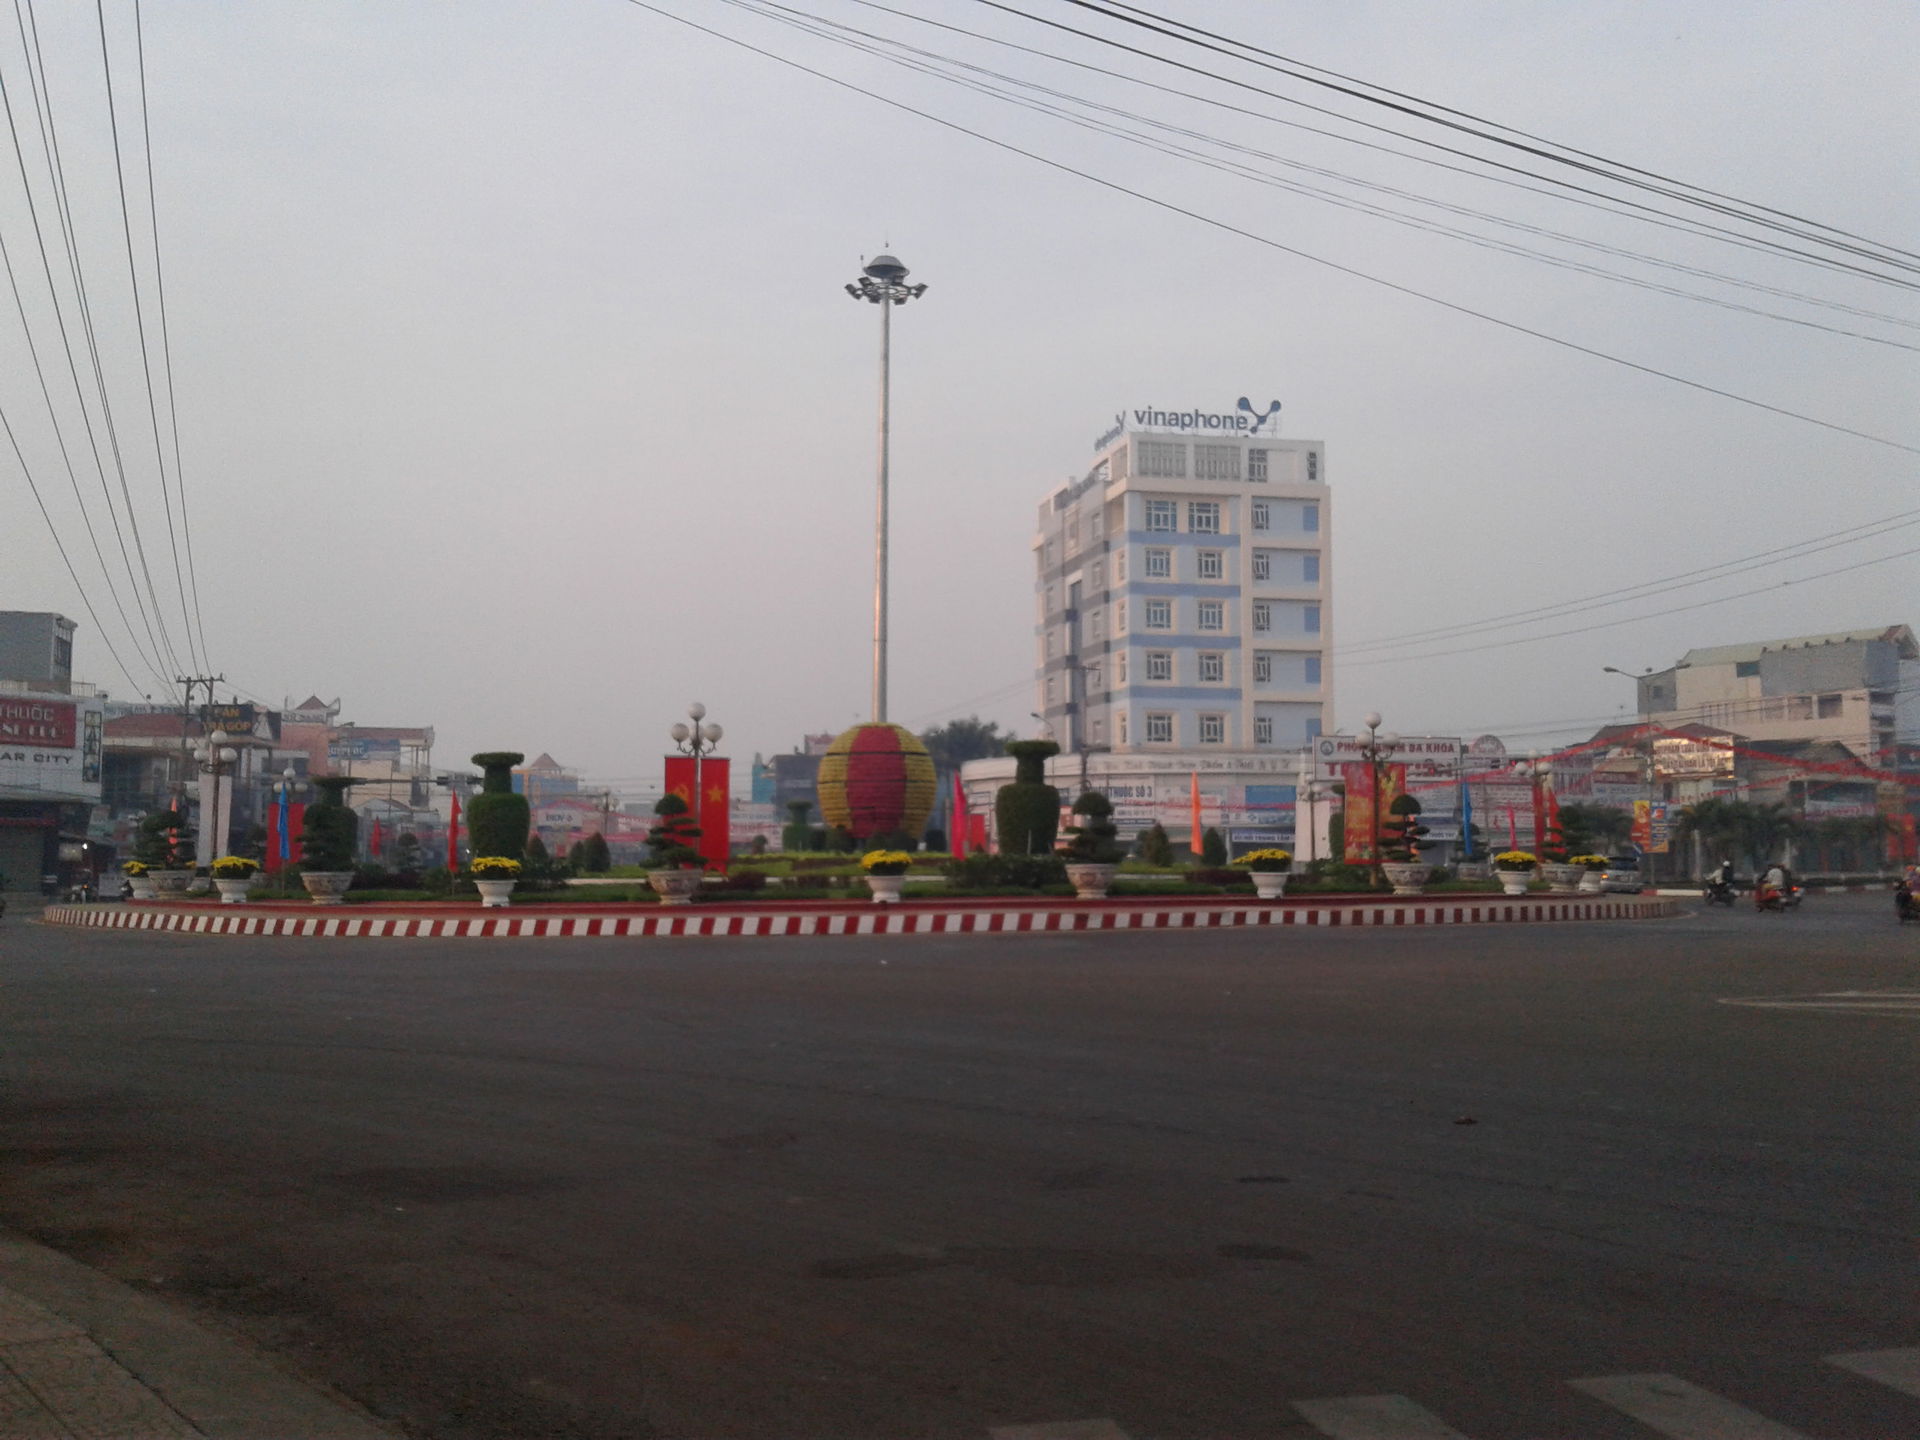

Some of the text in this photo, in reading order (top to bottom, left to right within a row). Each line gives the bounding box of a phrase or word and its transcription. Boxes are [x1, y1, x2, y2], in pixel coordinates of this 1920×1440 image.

[1134, 405, 1248, 431] vinaphone
[33, 752, 73, 765] CITY
[1146, 785, 1153, 798] 3
